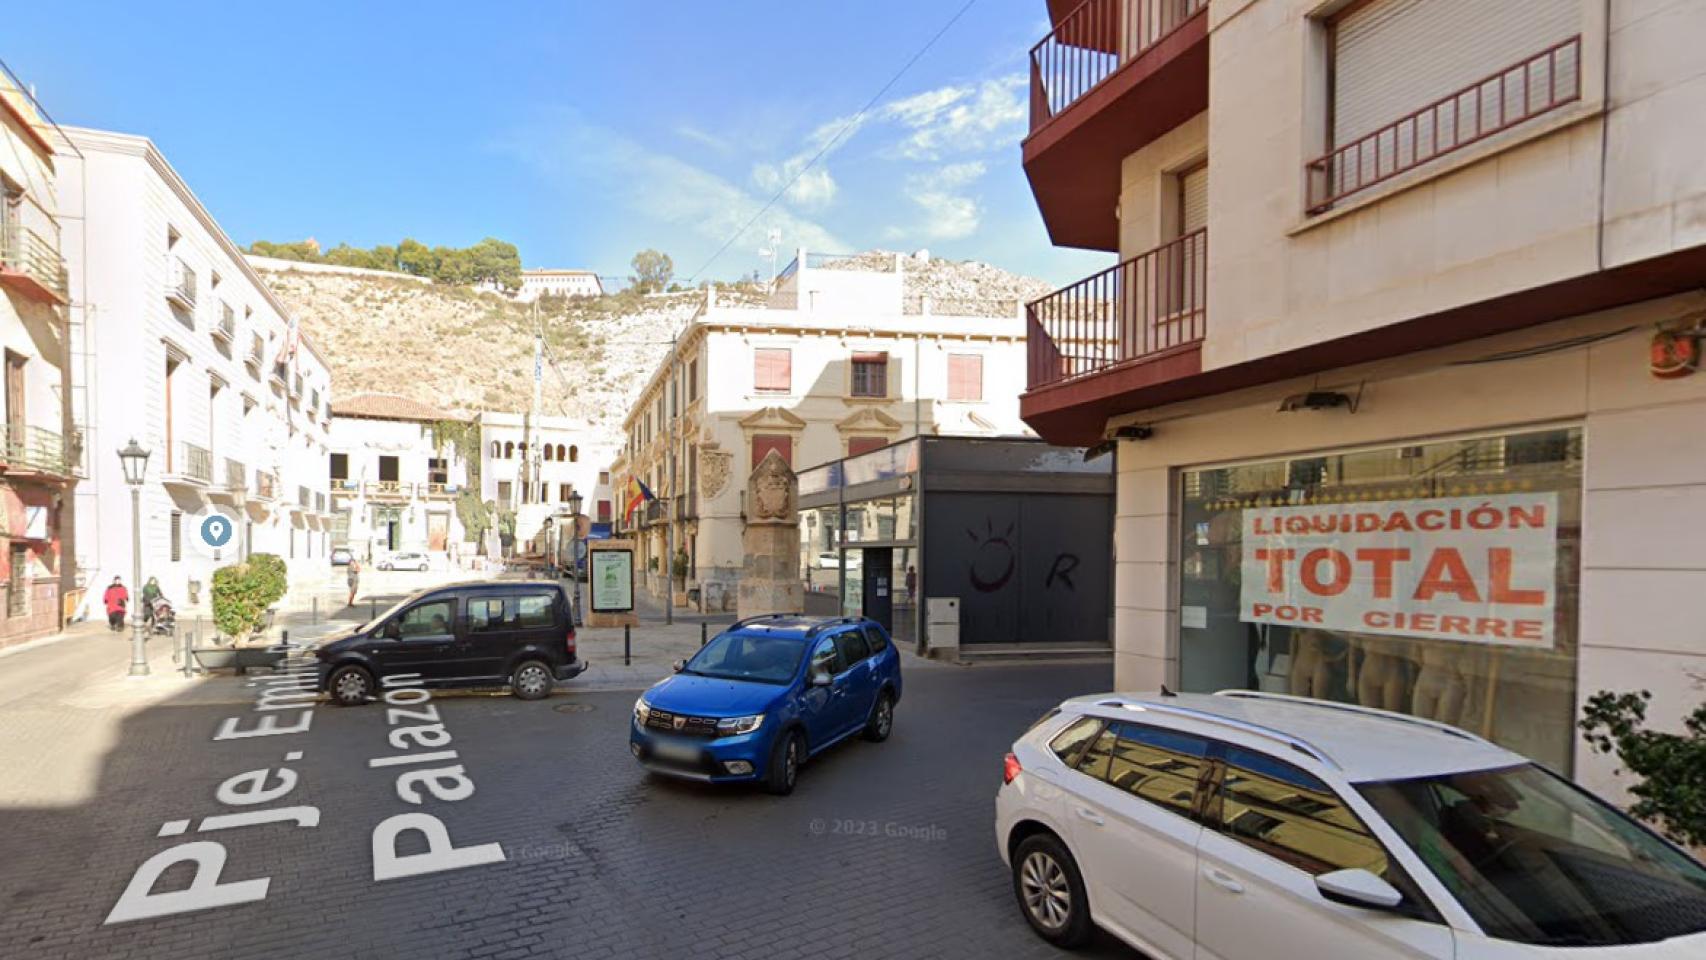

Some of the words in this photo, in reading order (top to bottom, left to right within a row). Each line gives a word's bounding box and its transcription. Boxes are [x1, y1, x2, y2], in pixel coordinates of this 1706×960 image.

[1253, 503, 1546, 536] LIQUIDACIÓN
[1255, 547, 1546, 606] TOTAL
[1253, 603, 1324, 623] POR
[1363, 611, 1543, 640] CIERRE
